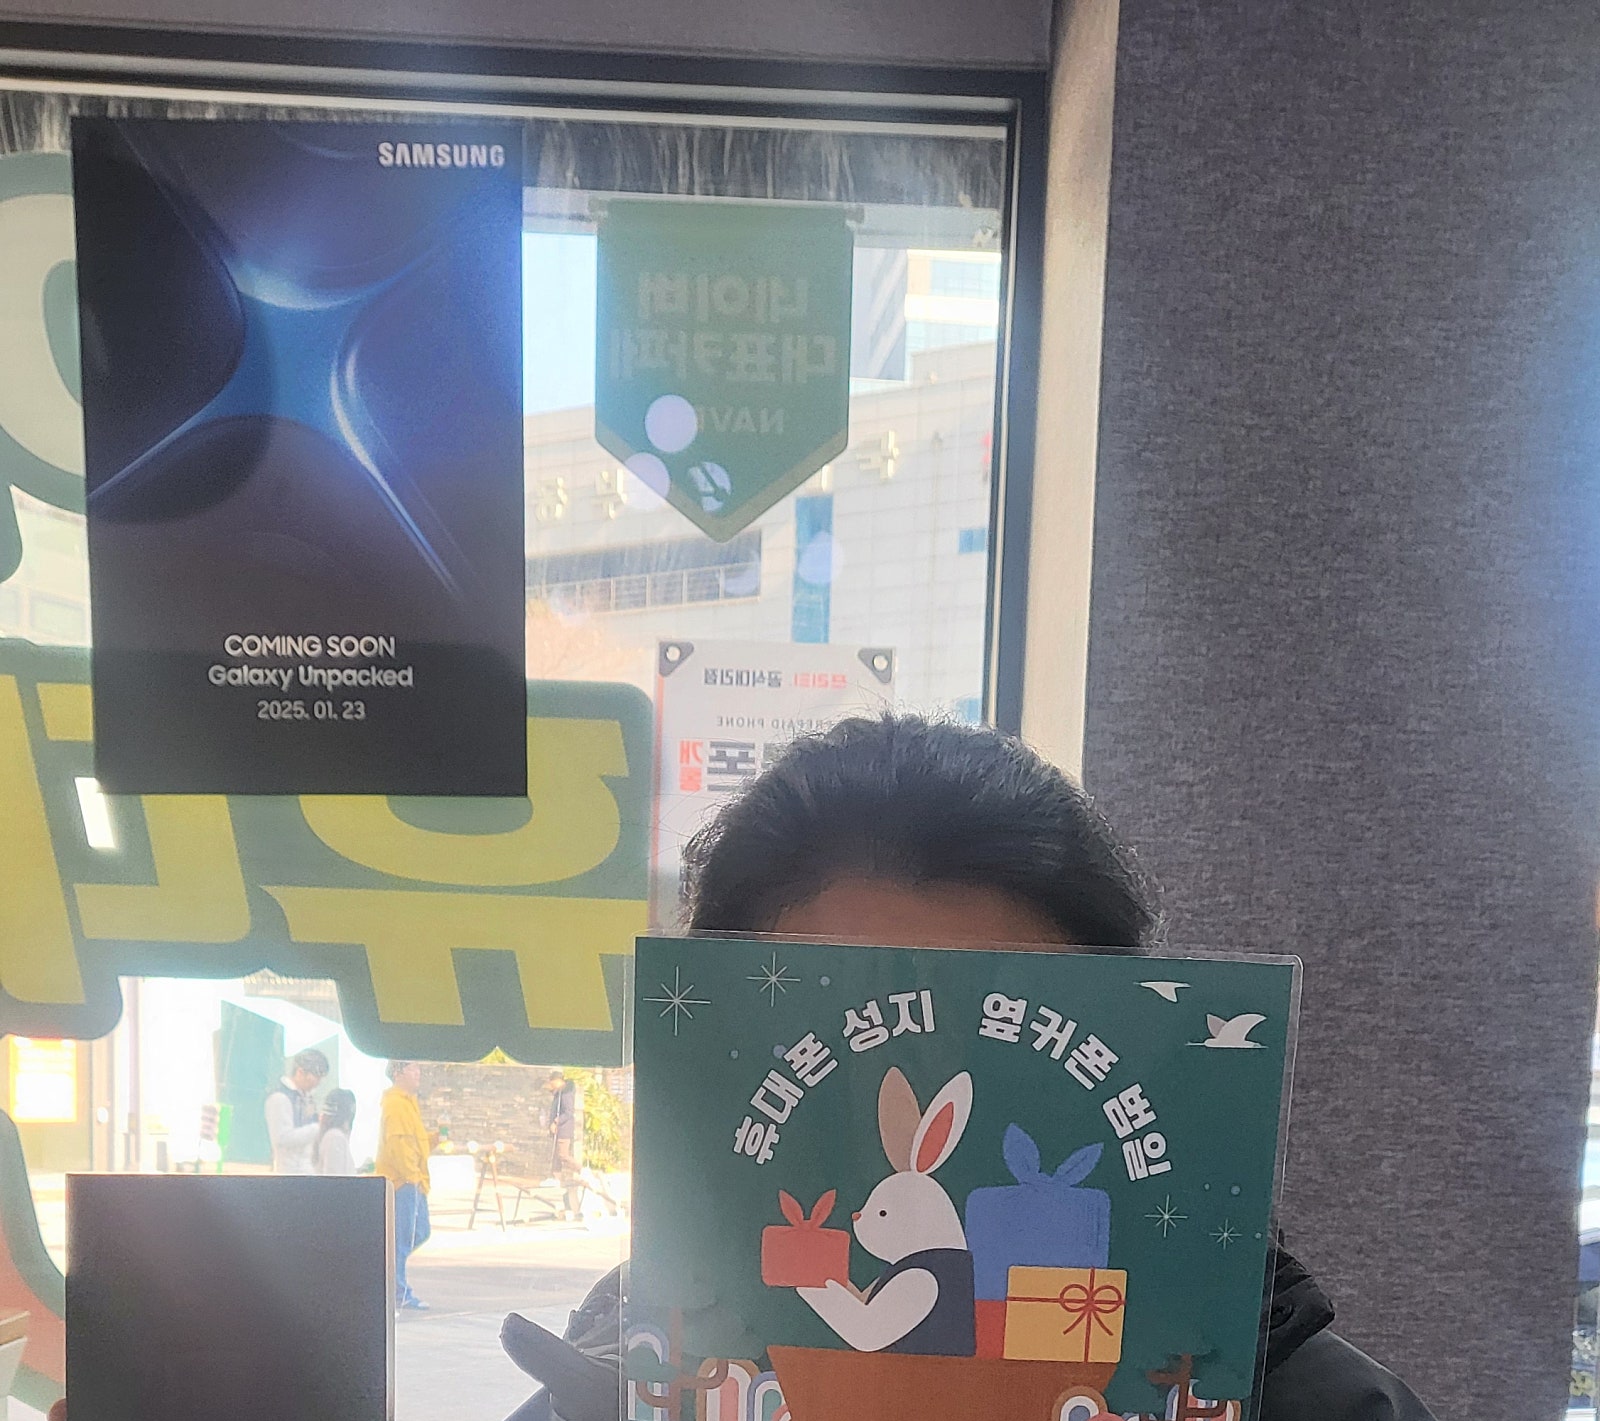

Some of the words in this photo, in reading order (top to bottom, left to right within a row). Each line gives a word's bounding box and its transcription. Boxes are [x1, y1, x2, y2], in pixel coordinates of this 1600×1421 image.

[378, 142, 505, 168] SAMSUNG
[224, 634, 322, 658] COMING
[326, 635, 396, 658] SOON
[207, 664, 293, 692] Galaxy
[299, 664, 413, 692] Unpacked
[257, 700, 309, 720] 2025.
[313, 700, 338, 720] 01.
[342, 700, 366, 720] 23
[732, 1031, 839, 1165] 휴대폰
[842, 989, 937, 1053] 성지
[978, 992, 1119, 1091] 옆커폰
[1102, 1083, 1173, 1182] 범일
